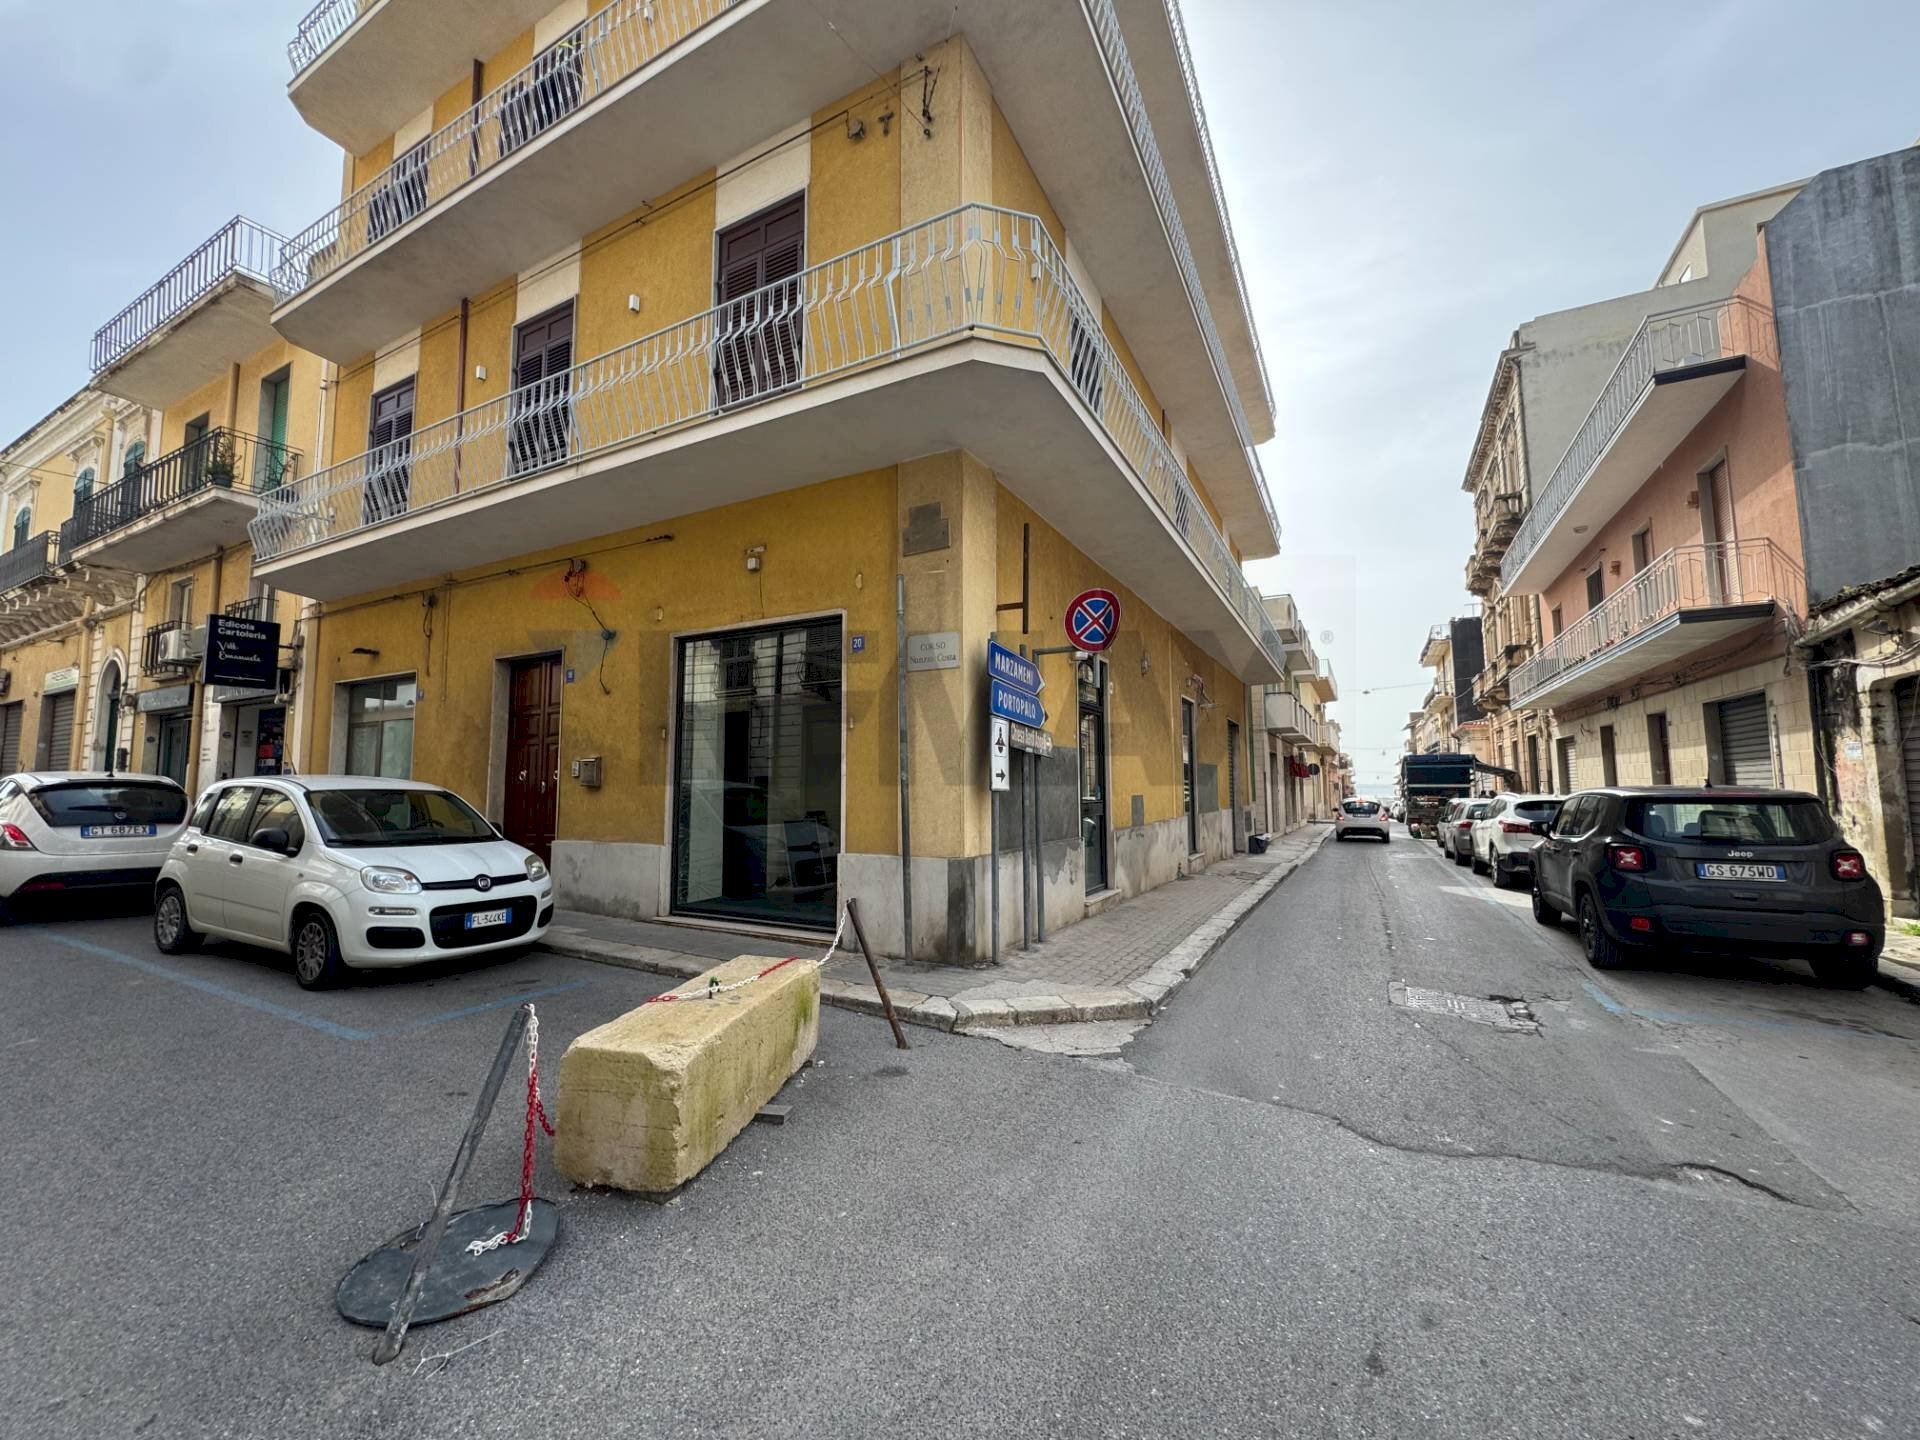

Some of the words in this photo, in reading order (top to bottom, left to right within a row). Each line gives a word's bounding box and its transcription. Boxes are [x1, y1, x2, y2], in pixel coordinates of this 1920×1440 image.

[218, 619, 255, 631] Edicola
[218, 627, 267, 640] Cartoleria
[853, 637, 862, 649] 20
[994, 652, 1034, 686] MARZAMEMI
[998, 689, 1036, 720] PORTOPALO
[1728, 850, 1753, 858] Jeep
[1707, 865, 1724, 876] GS
[1729, 866, 1774, 878] 675WD
